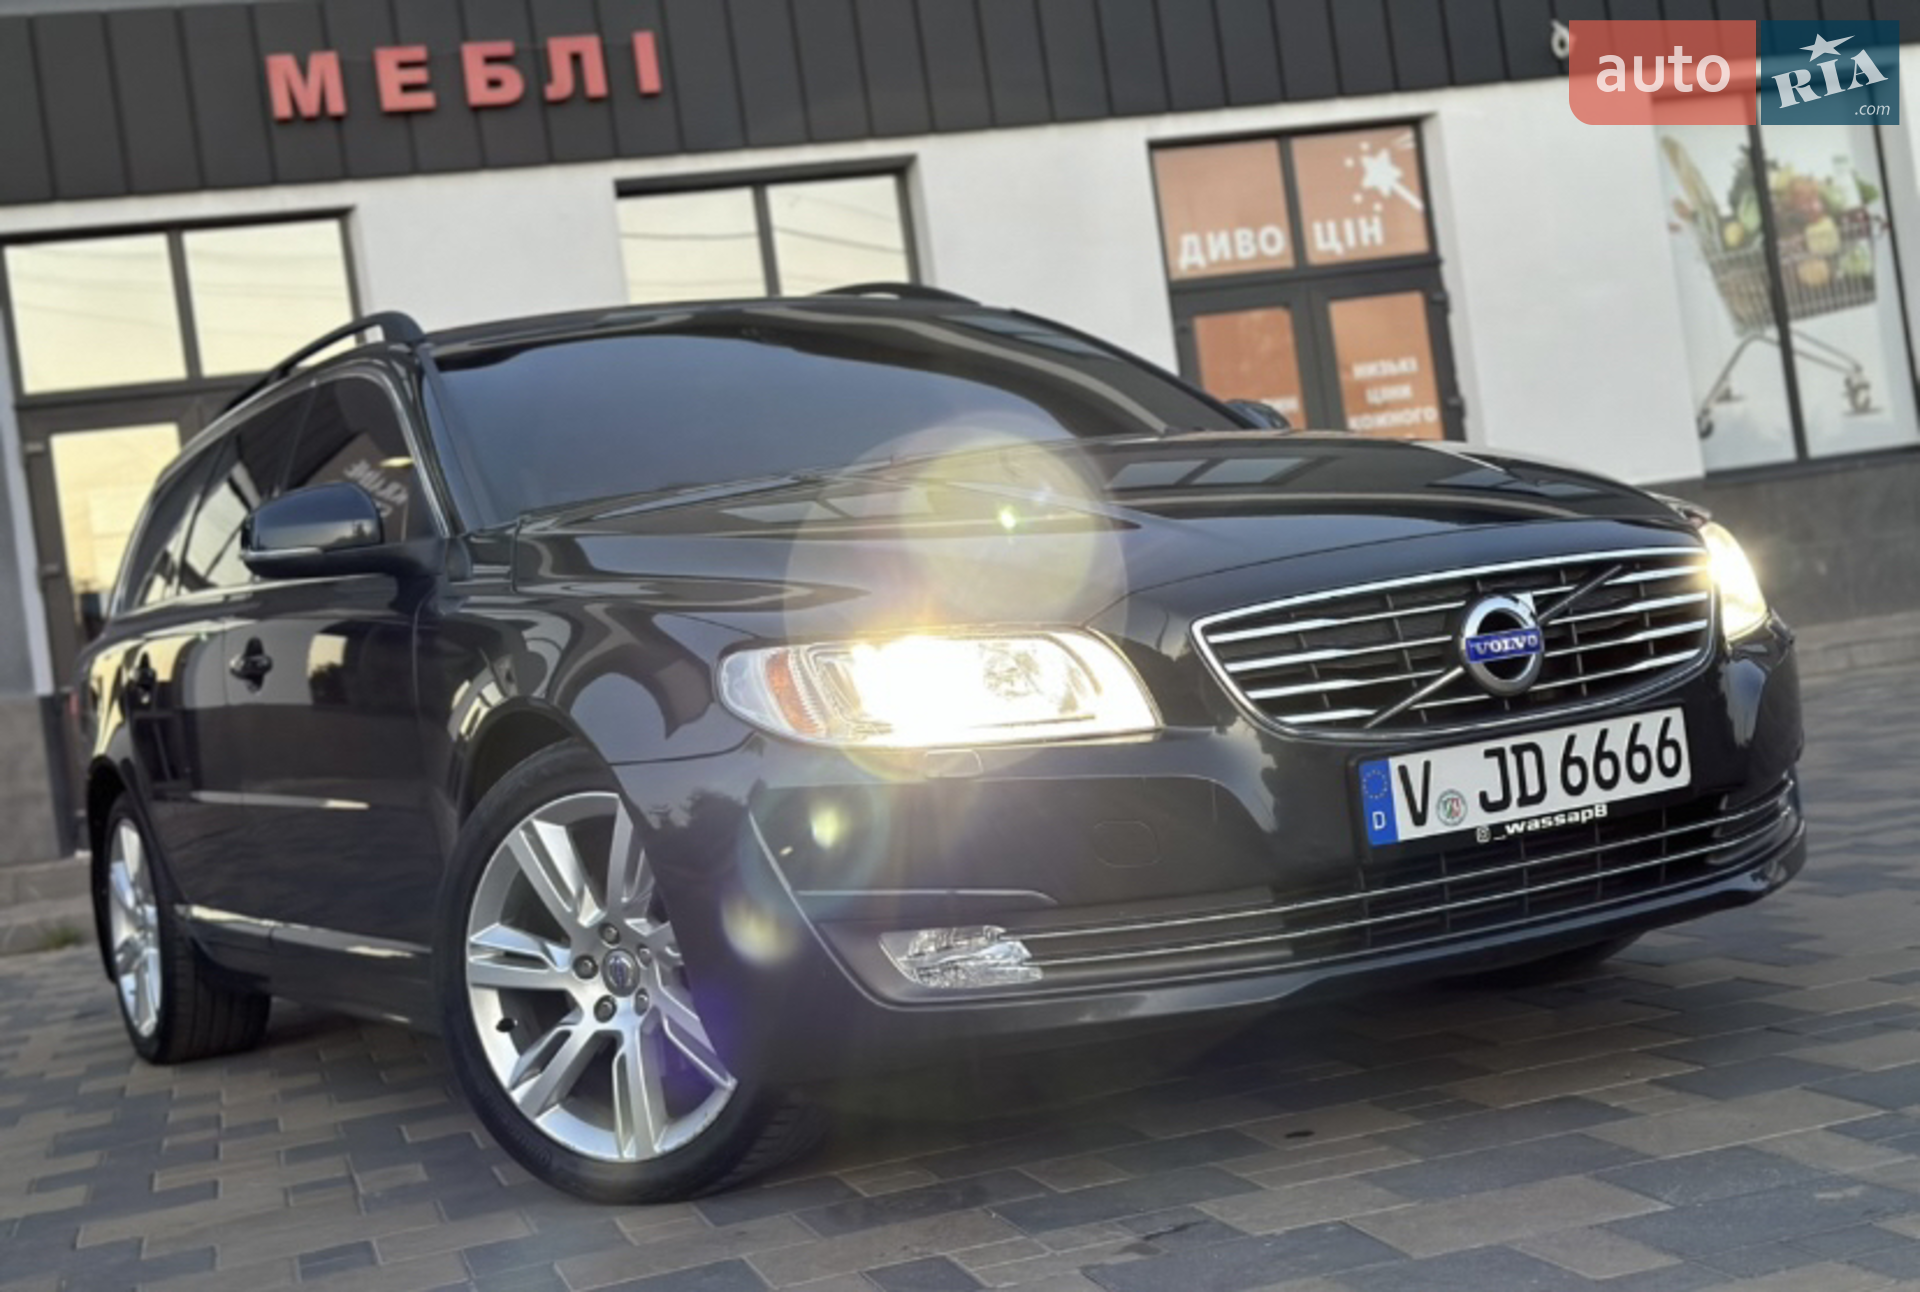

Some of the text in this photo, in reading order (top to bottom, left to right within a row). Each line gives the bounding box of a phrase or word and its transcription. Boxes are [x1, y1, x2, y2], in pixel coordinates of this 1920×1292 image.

[265, 29, 662, 121] МЕБЛІ
[1178, 214, 1385, 271] ДИВО ЦІН
[1474, 634, 1539, 656] VOLVO
[1397, 716, 1682, 827] V JD 6666
[1371, 810, 1387, 831] D
